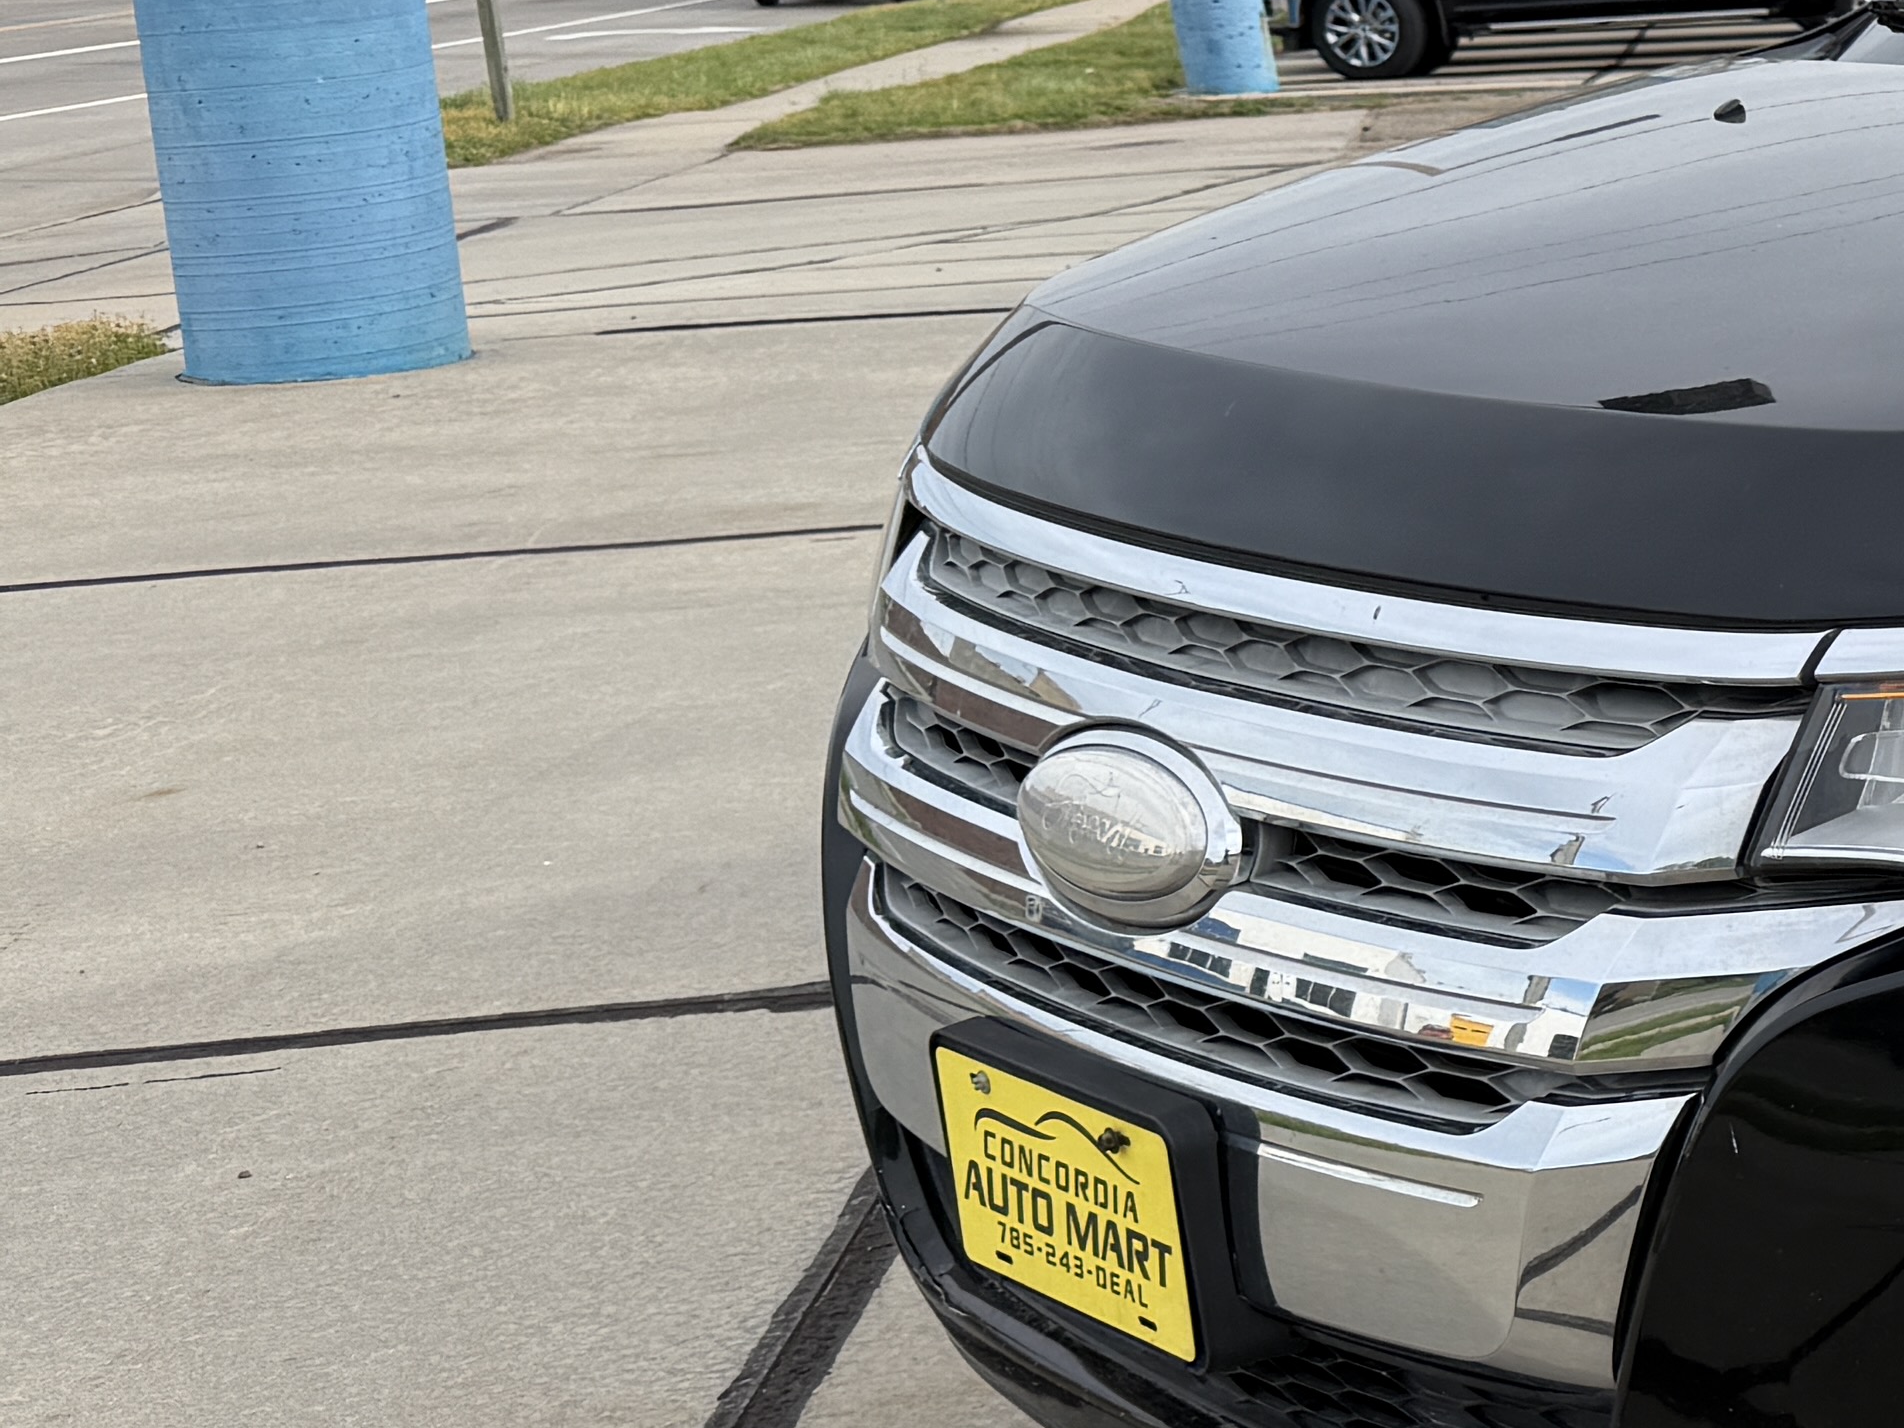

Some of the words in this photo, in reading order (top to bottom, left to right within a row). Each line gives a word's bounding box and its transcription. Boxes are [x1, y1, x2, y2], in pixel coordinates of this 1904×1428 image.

[964, 1159, 1055, 1237] AUTO
[1066, 1202, 1173, 1288] MART
[984, 1130, 1139, 1224] CONCORDIA
[997, 1221, 1149, 1309] 785-243-DEAL
